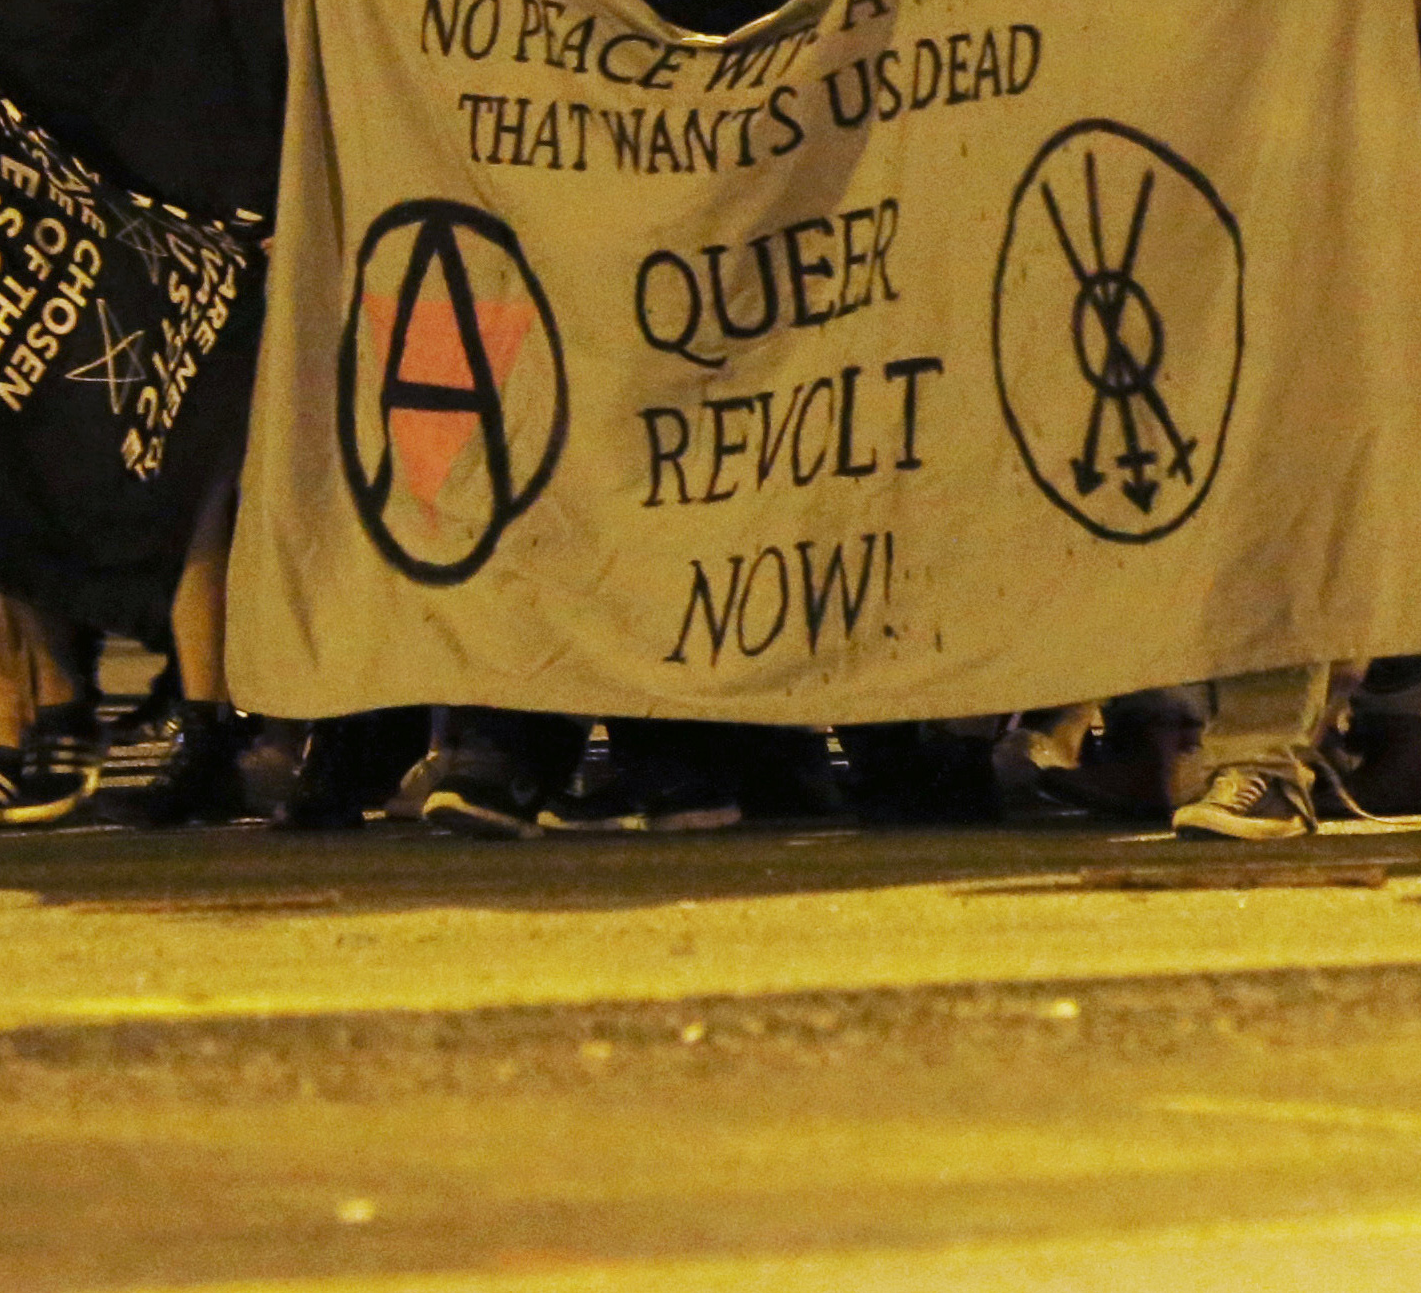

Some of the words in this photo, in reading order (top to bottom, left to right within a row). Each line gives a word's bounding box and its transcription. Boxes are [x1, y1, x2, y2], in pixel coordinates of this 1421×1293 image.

[458, 93, 588, 171] THAT
[590, 83, 802, 174] WANTS
[822, 49, 901, 128] US
[900, 25, 1041, 110] DEAD
[704, 24, 818, 93] WIT
[24, 217, 68, 281] OF
[635, 197, 900, 368] QUEER
[638, 357, 943, 507] REVOLT
[664, 532, 897, 667] NOW!
